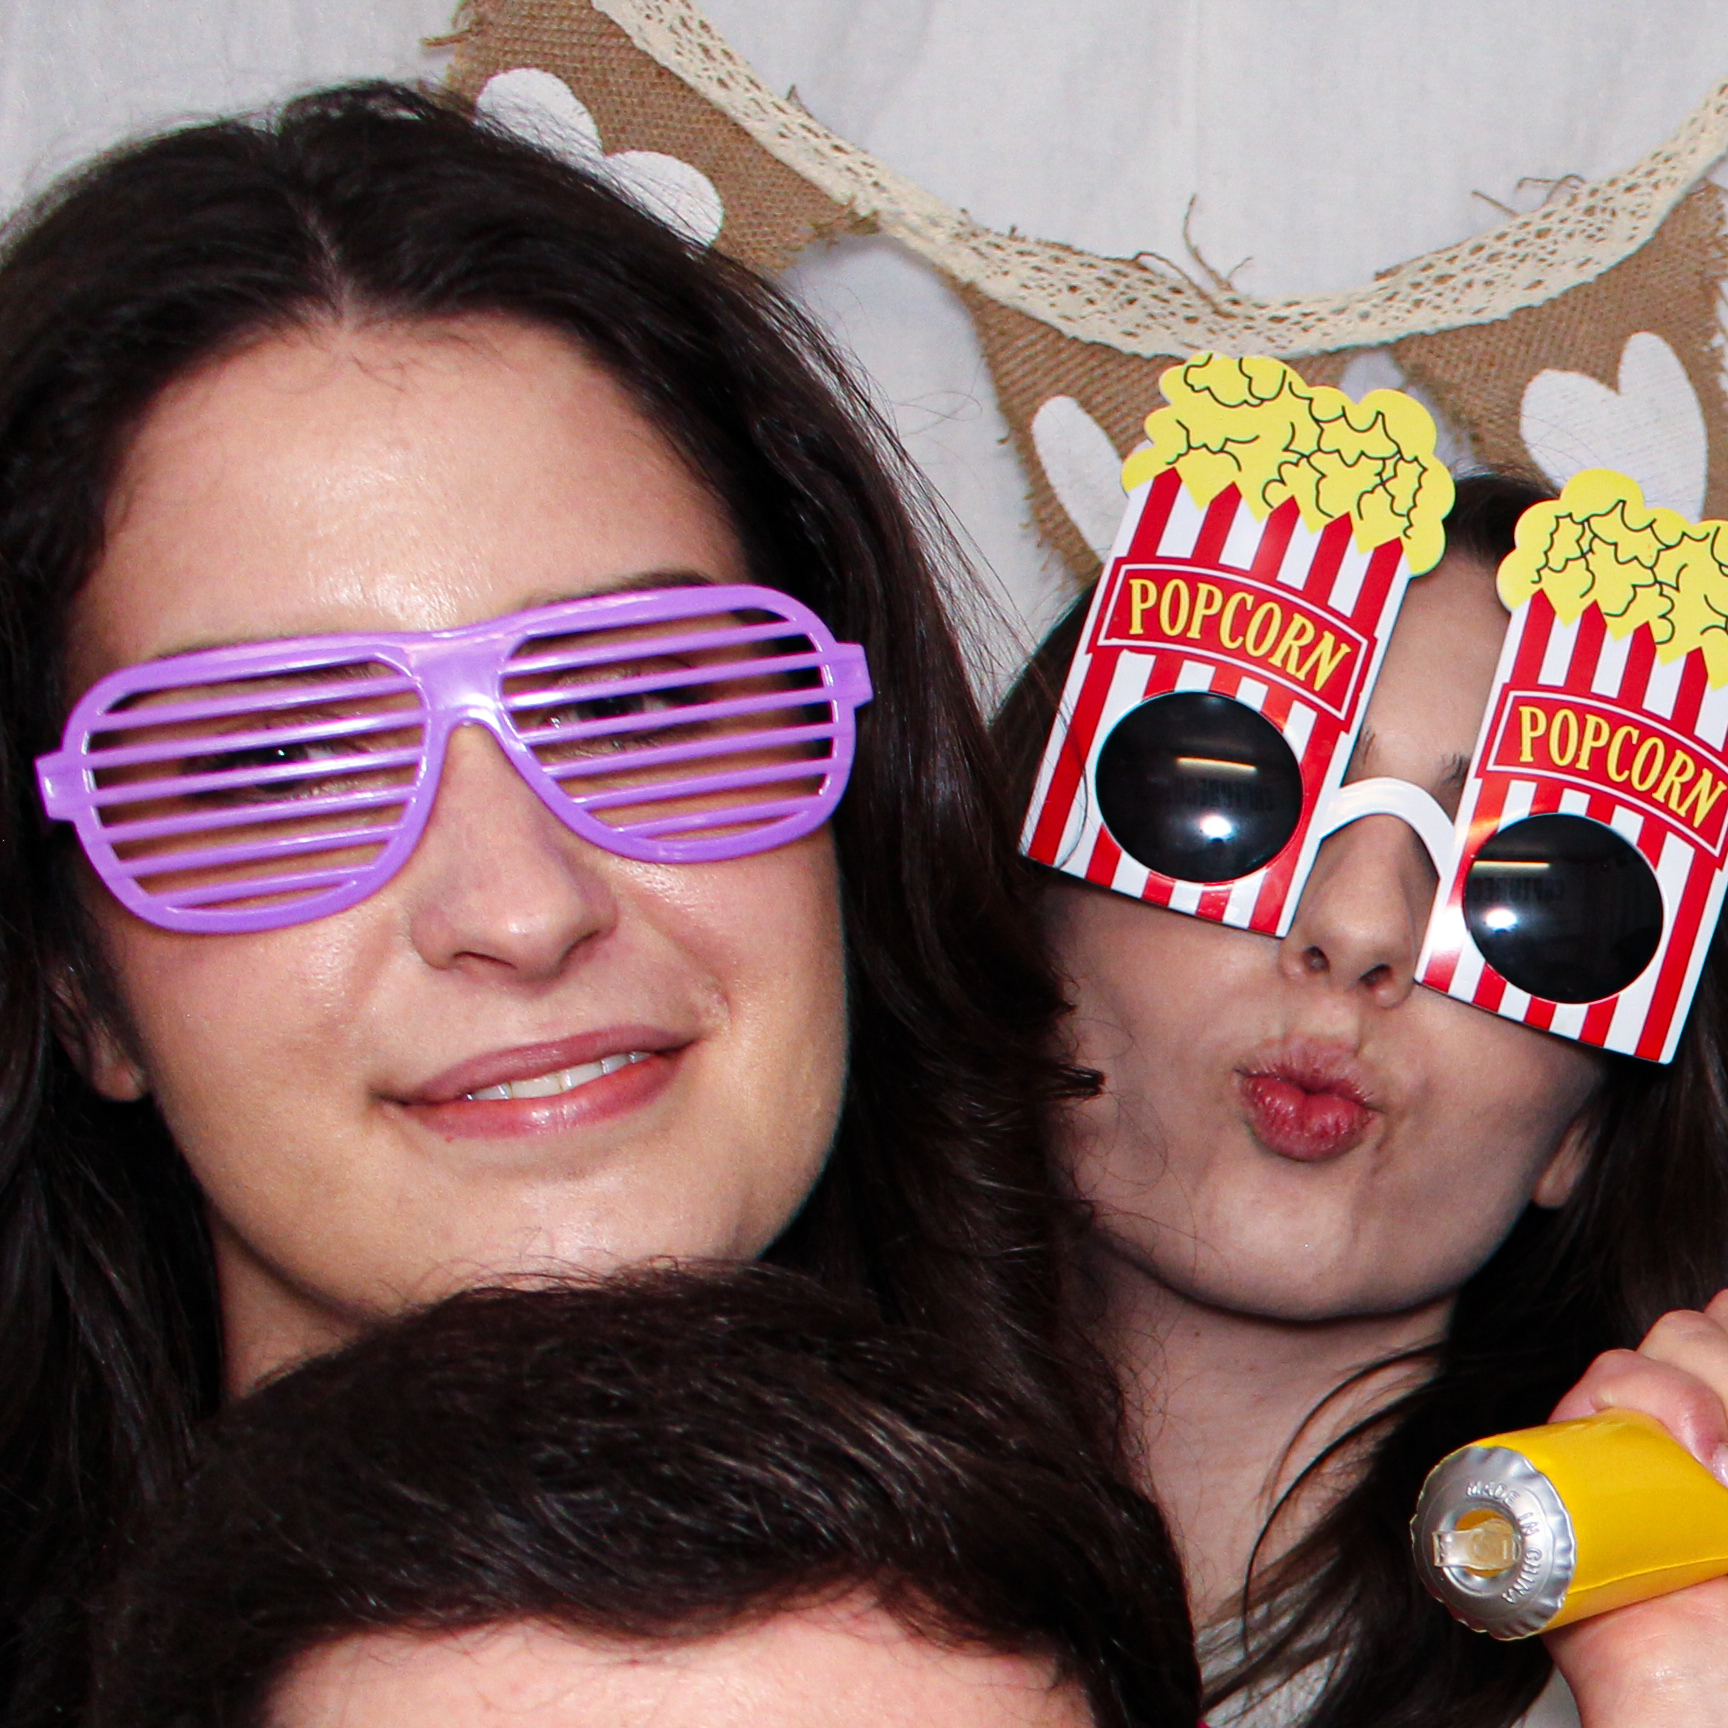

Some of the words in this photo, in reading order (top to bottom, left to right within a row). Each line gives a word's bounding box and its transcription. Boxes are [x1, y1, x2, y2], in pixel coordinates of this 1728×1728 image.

[1128, 578, 1351, 692] POPCORN
[1518, 704, 1726, 830] POPCORN
[1466, 1480, 1520, 1507] MADE
[1518, 1511, 1540, 1538] IN
[1501, 1547, 1543, 1604] CHINA
